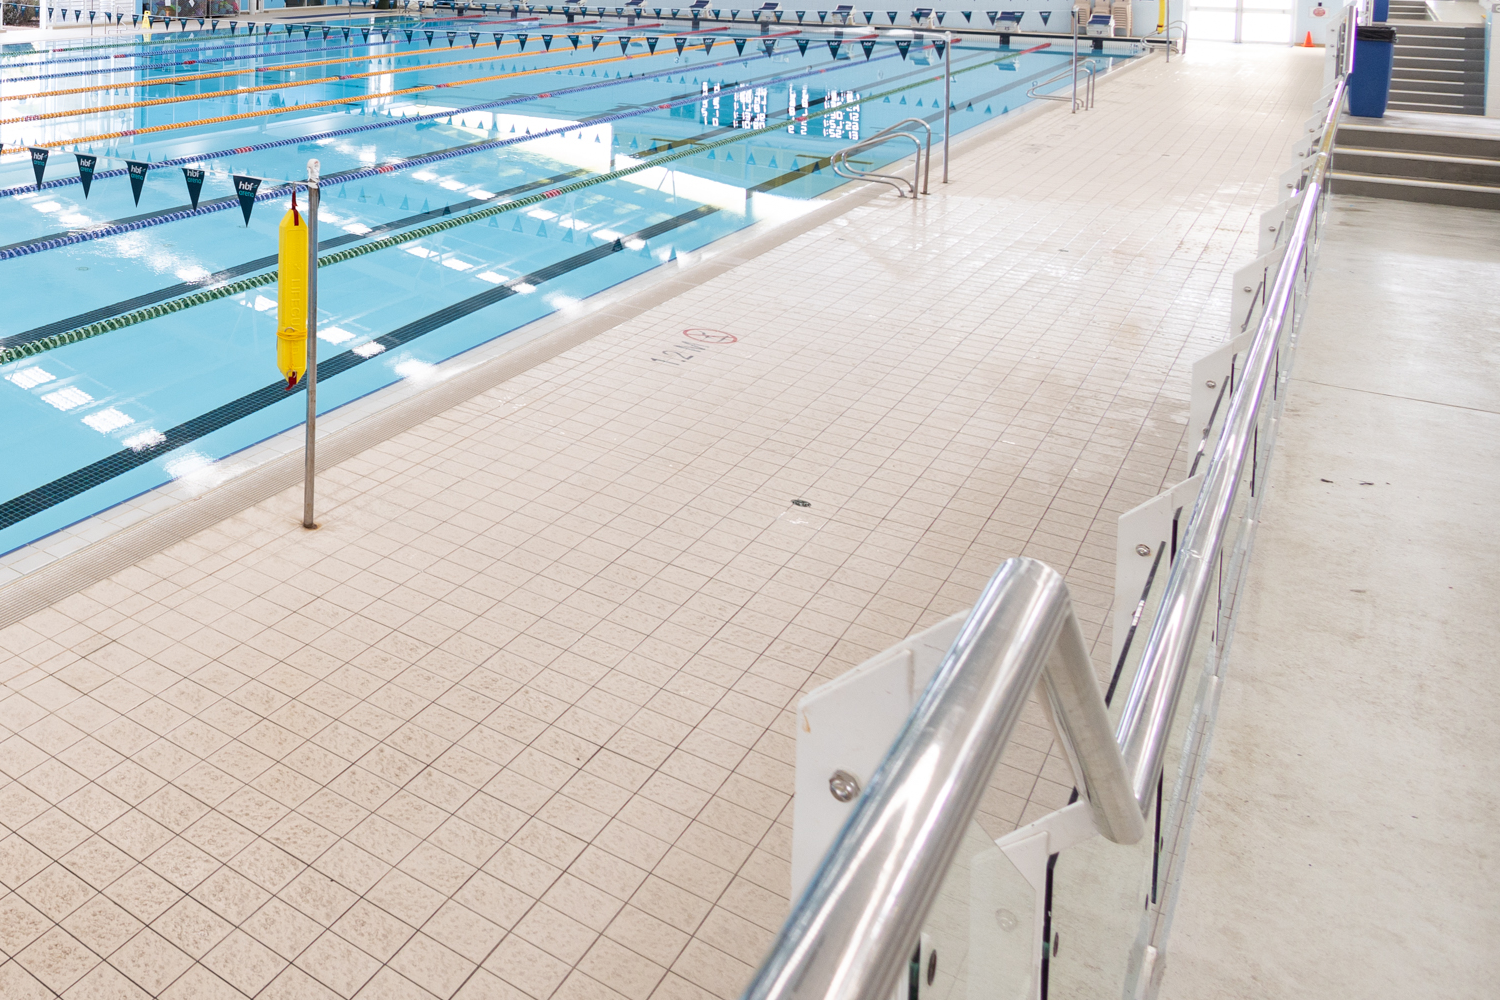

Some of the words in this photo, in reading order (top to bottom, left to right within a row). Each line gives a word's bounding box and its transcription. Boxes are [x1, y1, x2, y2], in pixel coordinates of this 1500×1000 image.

[33, 152, 44, 161] hbf
[80, 158, 92, 167] hbf
[130, 165, 142, 174] hbf
[186, 169, 200, 178] hbf
[238, 181, 253, 191] hbf
[238, 190, 255, 198] arena
